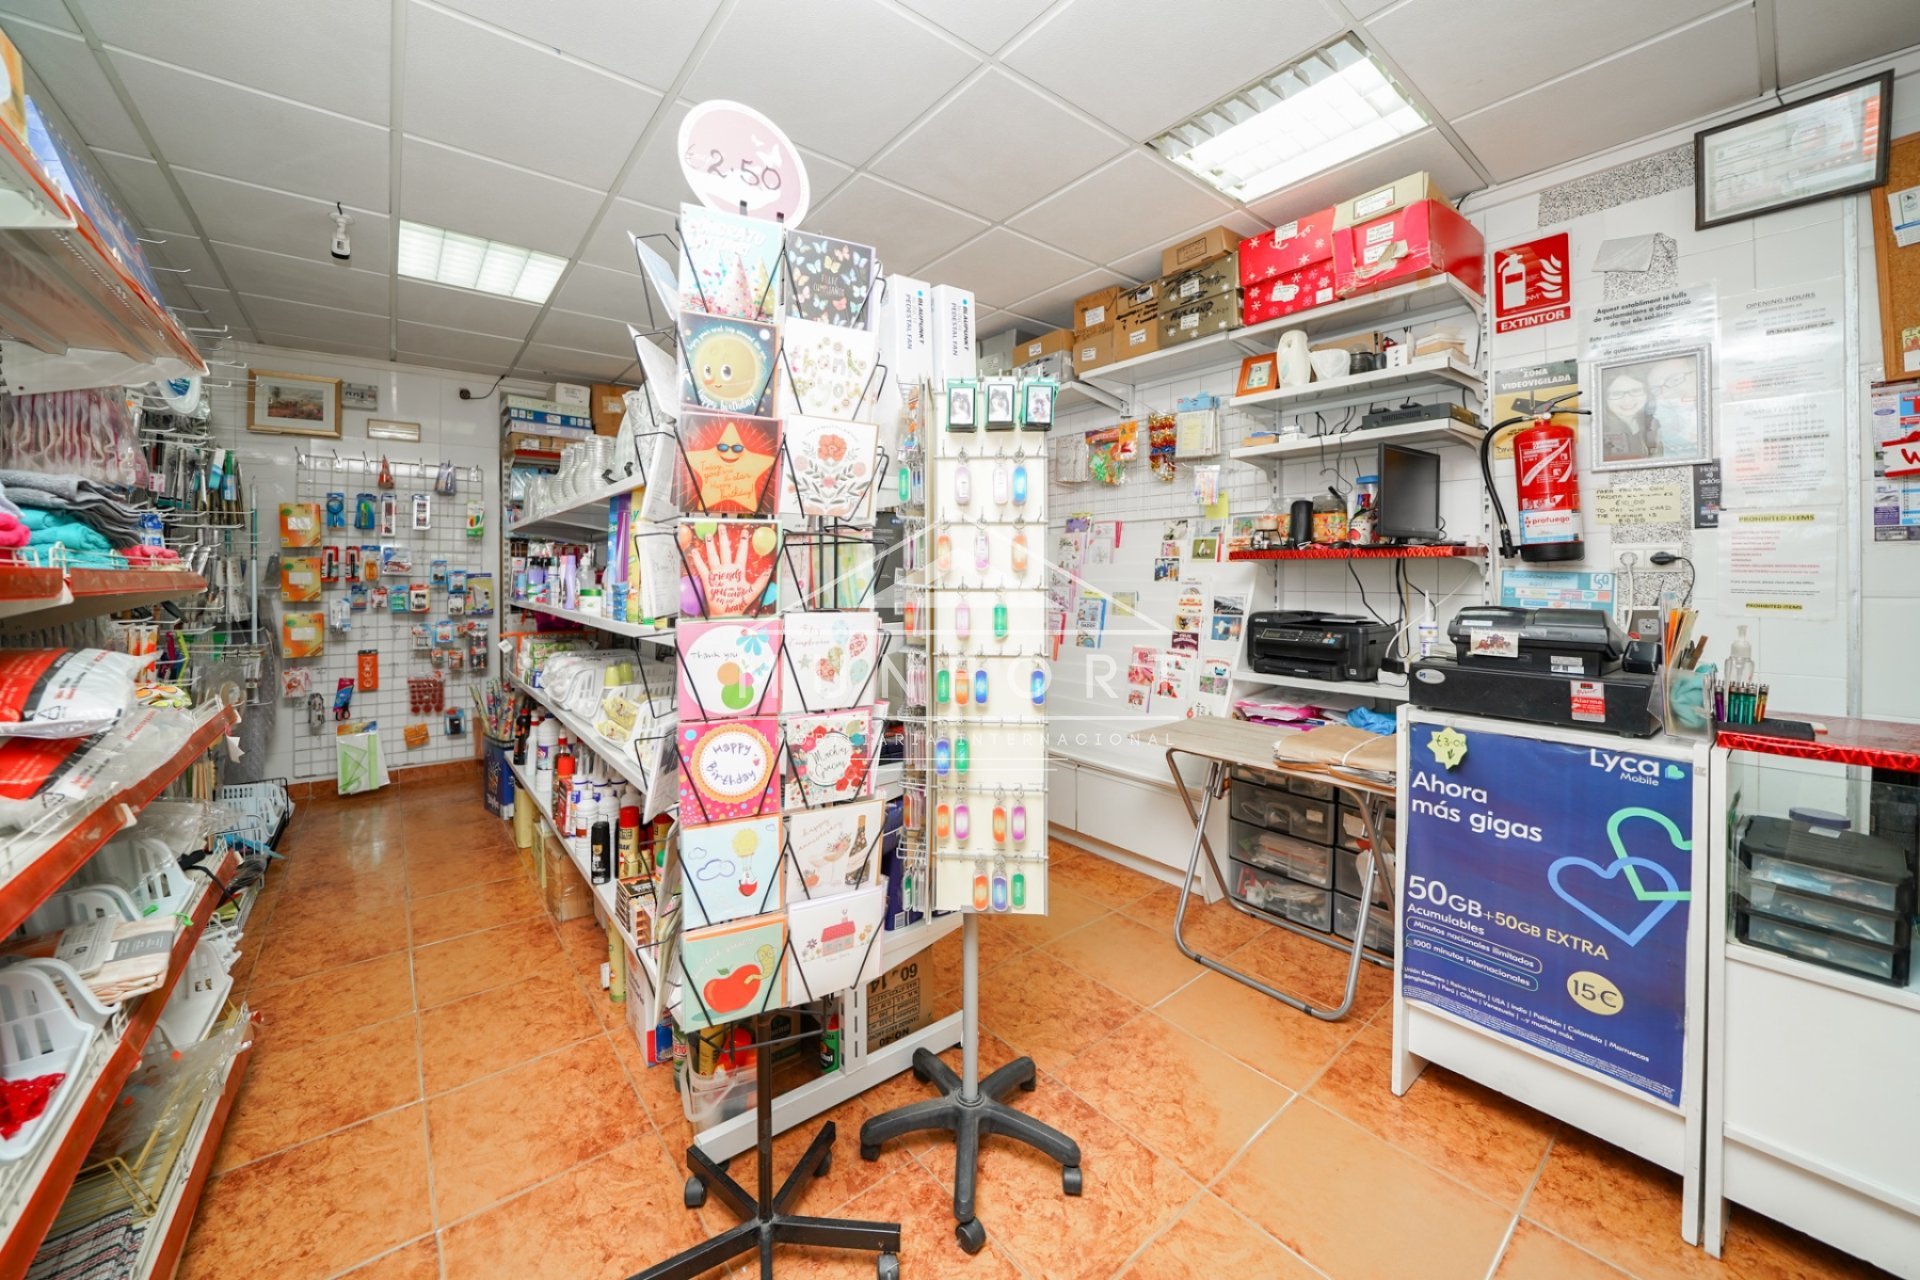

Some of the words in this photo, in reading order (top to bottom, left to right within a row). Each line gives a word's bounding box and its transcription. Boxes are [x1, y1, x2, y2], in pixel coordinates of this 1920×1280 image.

[1596, 305, 1619, 316] Aquest
[1621, 297, 1661, 310] establiment
[1671, 291, 1687, 300] fulls
[1745, 298, 1783, 310] OPENING
[1784, 292, 1816, 304] HOURS
[917, 298, 925, 345] BLAUPUNKT
[1501, 311, 1565, 332] EXTINTOR
[1501, 374, 1572, 390] VIDEOVIGILADA
[1523, 368, 1549, 378] ZONA
[1532, 515, 1570, 525] profuego
[1788, 513, 1815, 521] ITEMS
[712, 741, 752, 758] Happy
[1590, 748, 1660, 777] Lyca
[705, 762, 757, 786] Birthday
[1412, 771, 1488, 804] Ahora
[1619, 772, 1660, 787] Mobile
[1411, 798, 1461, 823] más
[1469, 809, 1543, 842] gigas
[1407, 903, 1485, 936] Acumulables
[1413, 920, 1445, 936] Minutos
[1446, 931, 1490, 952] nacionales
[1491, 945, 1535, 968] ilimitados
[1546, 928, 1610, 961] EXTRA
[1413, 938, 1432, 950] 1000
[1433, 945, 1465, 962] minutos
[1466, 956, 1531, 987] internacionales
[1483, 1000, 1516, 1018] Venezuela
[1531, 1019, 1557, 1035] muchos
[1491, 995, 1506, 1006] USA
[1568, 1025, 1603, 1044] Colombia
[1609, 1041, 1650, 1063] Marruecos
